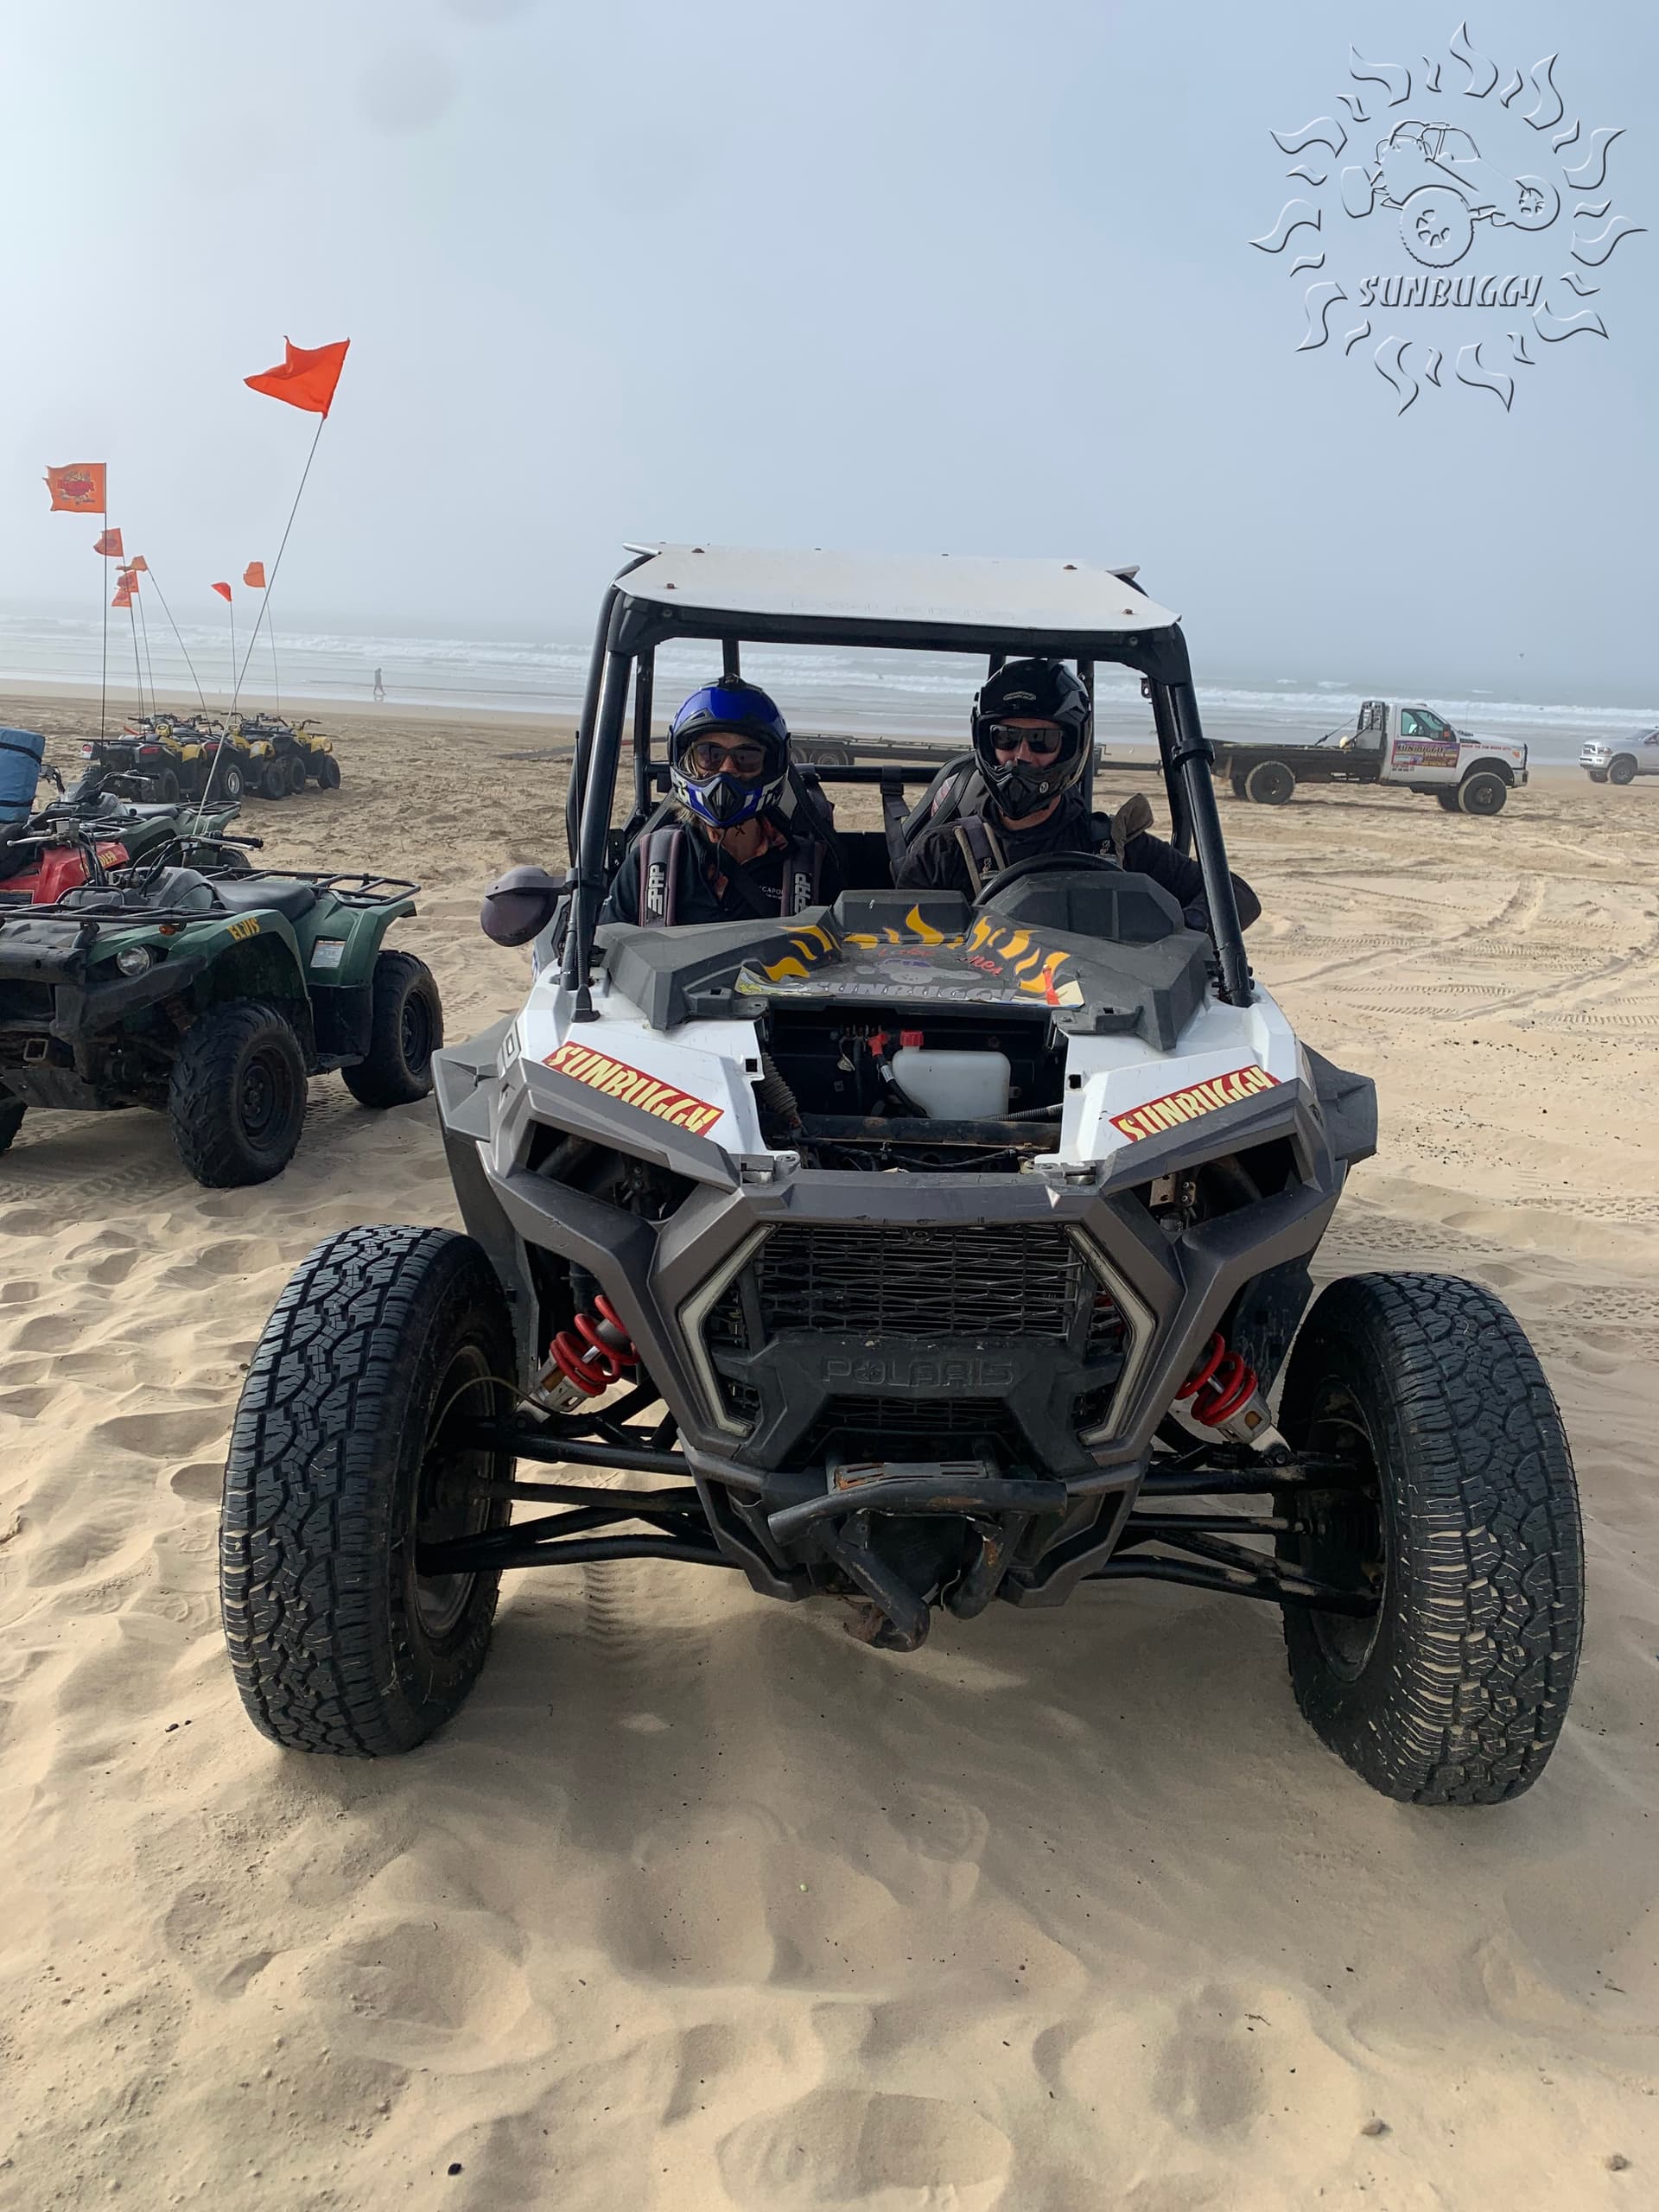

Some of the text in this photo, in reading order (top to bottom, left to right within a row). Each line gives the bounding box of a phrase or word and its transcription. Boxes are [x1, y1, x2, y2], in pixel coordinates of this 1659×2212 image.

[226, 917, 260, 941] ELVIS
[549, 1045, 721, 1133] SUNBUGGY
[1118, 1066, 1275, 1141] SUNBUGGY
[823, 1356, 1014, 1387] POLARIS
